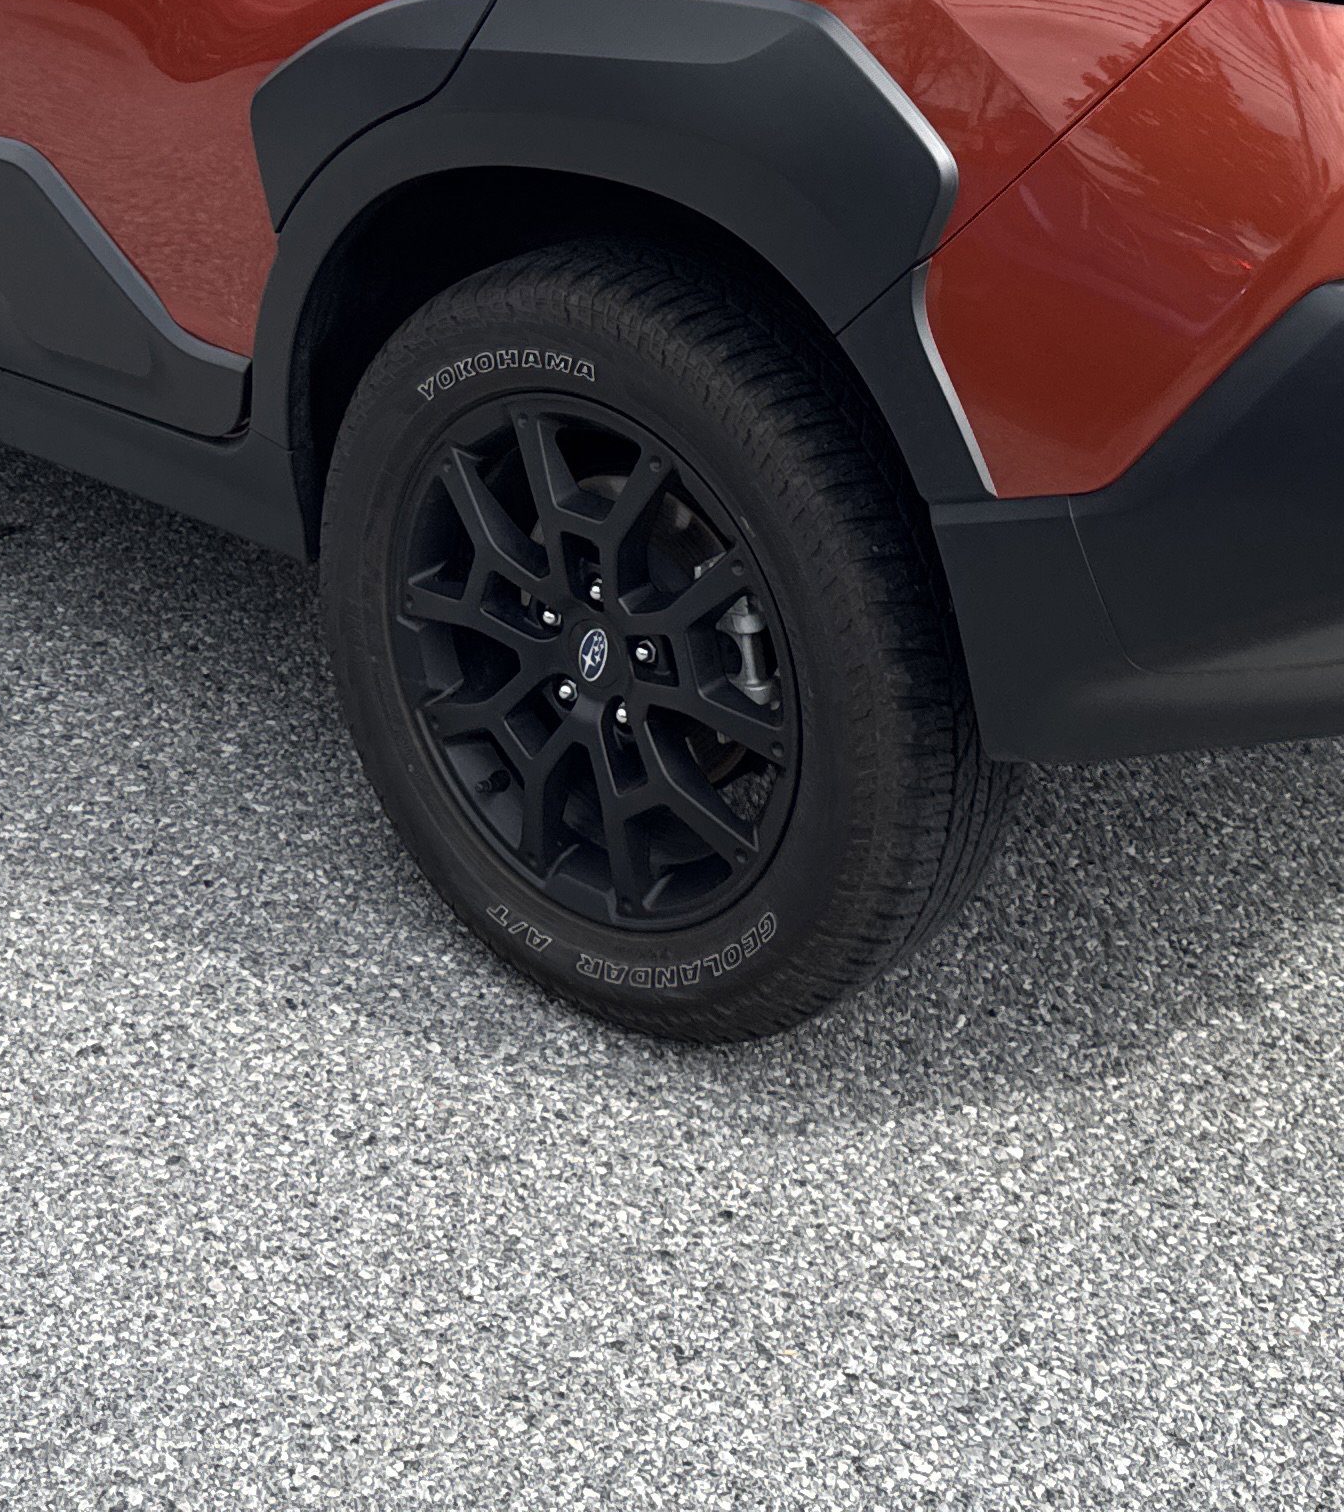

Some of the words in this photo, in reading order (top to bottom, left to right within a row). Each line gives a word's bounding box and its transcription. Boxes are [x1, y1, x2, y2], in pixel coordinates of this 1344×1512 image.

[417, 349, 596, 401] YOKOHAMA
[486, 903, 553, 953] A/T
[576, 910, 777, 988] GEOLANDAR
